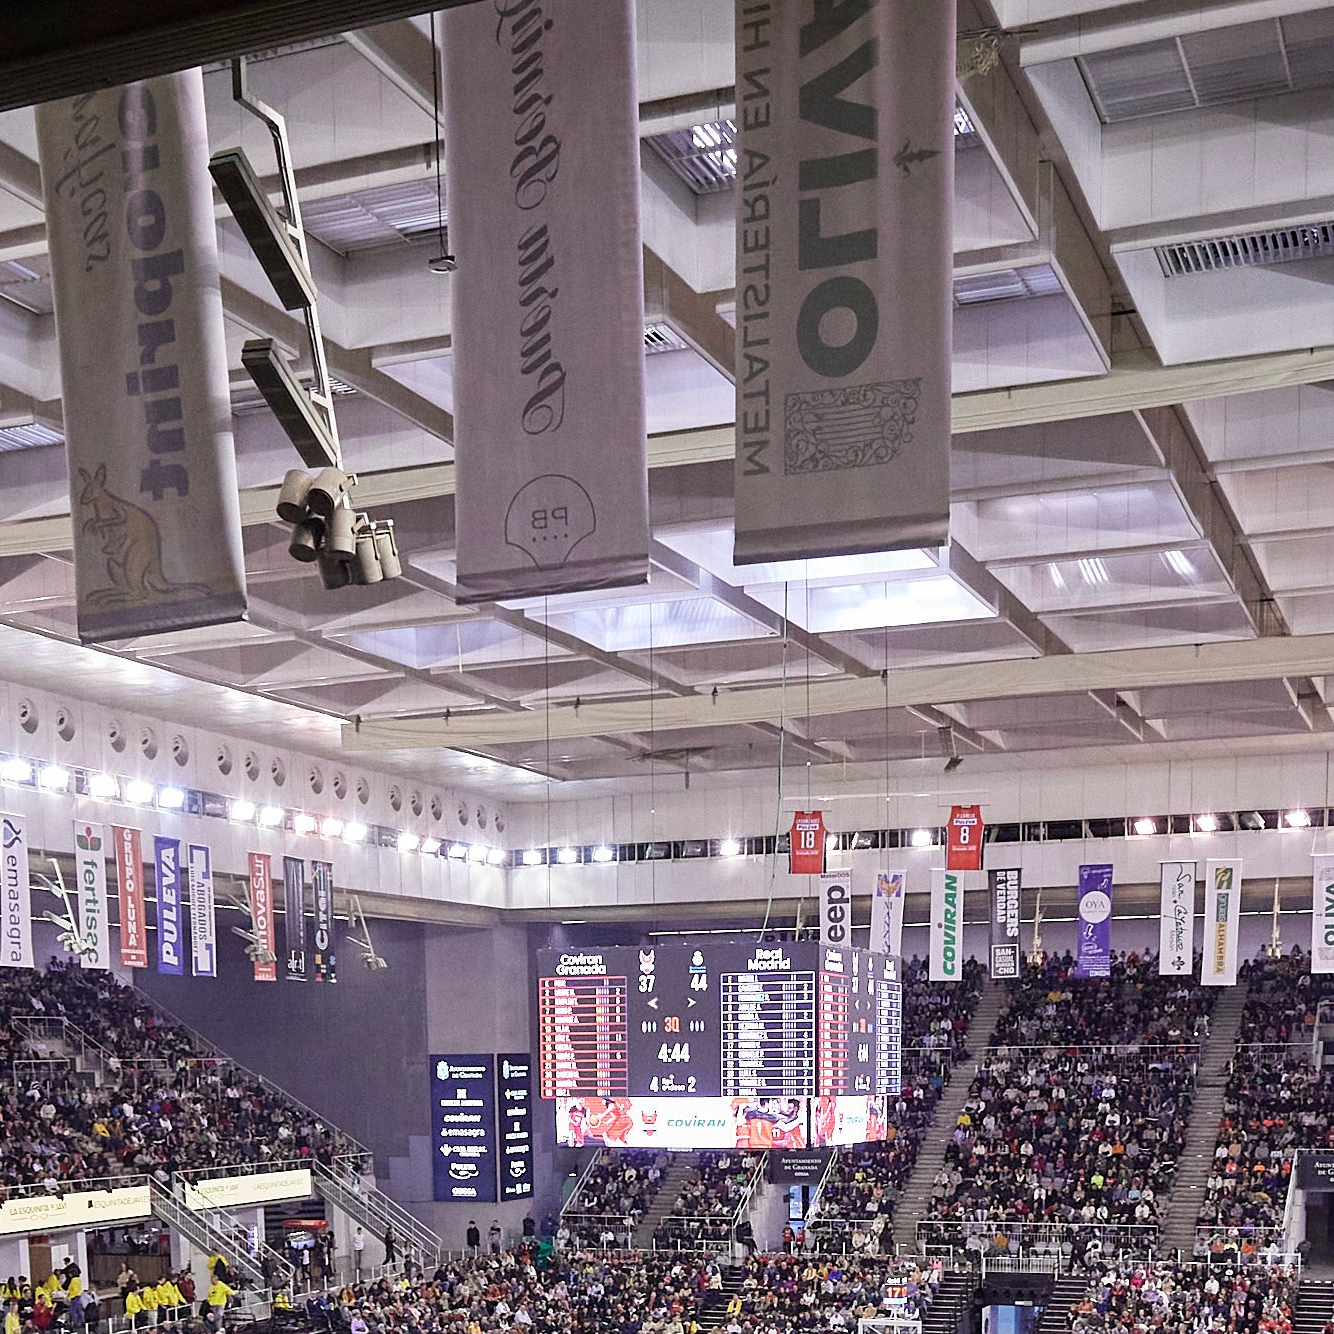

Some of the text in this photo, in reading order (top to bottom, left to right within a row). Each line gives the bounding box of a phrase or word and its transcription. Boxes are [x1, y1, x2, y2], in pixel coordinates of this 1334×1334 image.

[799, 831, 815, 849] 18
[959, 825, 970, 845] 8
[123, 828, 135, 892] GRUPO
[6, 855, 22, 962] emasagra
[161, 848, 179, 966] PULEVA
[196, 881, 208, 941] ABOGADOS
[827, 884, 850, 943] eep
[996, 883, 1006, 923] VERDAD
[1006, 870, 1019, 937] BURGERS
[1085, 901, 1105, 909] OYA
[937, 874, 957, 976] COVIRAN
[1214, 923, 1227, 974] ALHAMBRA
[638, 975, 655, 992] 37
[690, 974, 708, 991] 44
[657, 1043, 690, 1063] 4:44
[650, 1077, 659, 1092] 4
[688, 1076, 696, 1092] 2
[667, 1115, 726, 1128] COVIRAN
